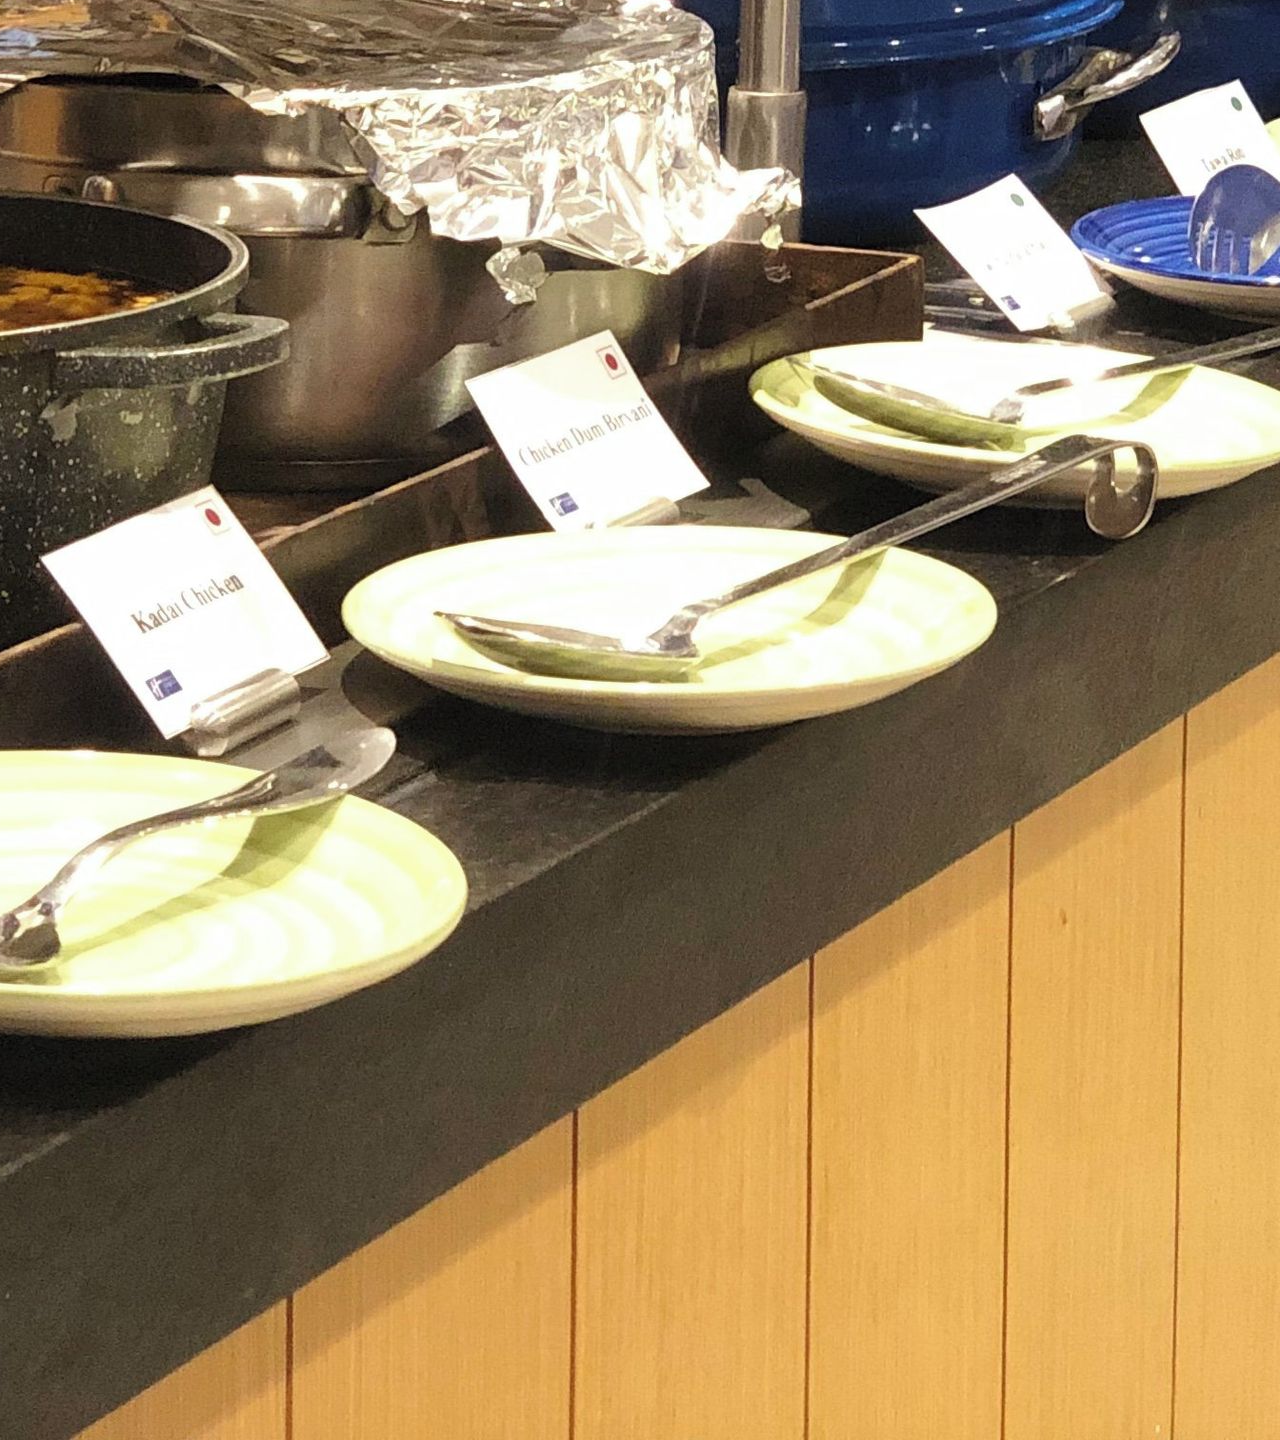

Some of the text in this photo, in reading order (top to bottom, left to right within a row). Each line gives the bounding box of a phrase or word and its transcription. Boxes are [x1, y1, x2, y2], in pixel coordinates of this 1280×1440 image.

[569, 424, 606, 446] Dum
[130, 574, 245, 634] Kadai Chicken
